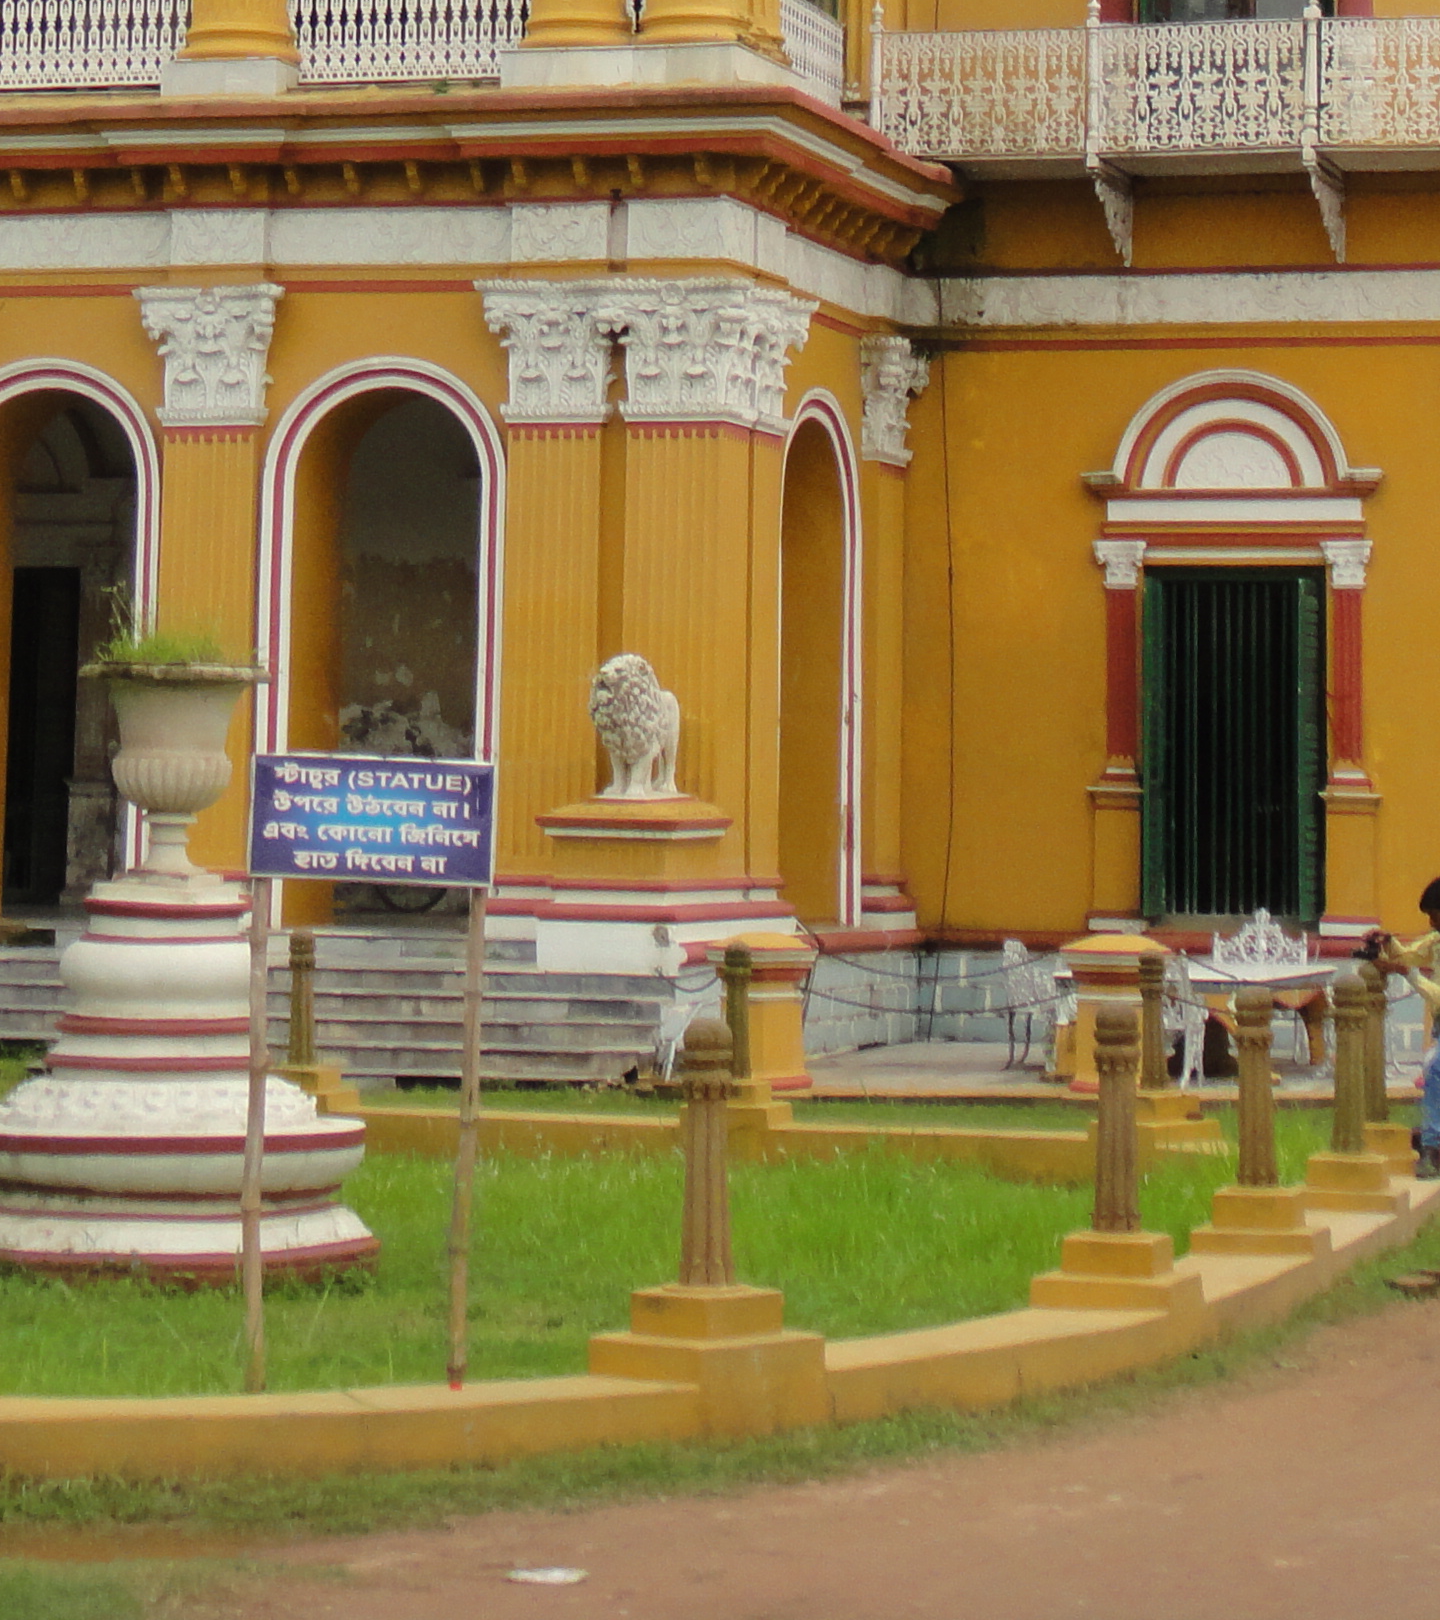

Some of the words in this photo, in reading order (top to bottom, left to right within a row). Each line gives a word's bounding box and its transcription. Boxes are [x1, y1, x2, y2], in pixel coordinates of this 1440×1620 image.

[348, 770, 472, 796] (STATUE)
[273, 789, 340, 814] উপরে
[346, 792, 427, 818] উঠবেন
[263, 821, 309, 840] এবং
[317, 824, 393, 843] কোনো
[399, 822, 481, 849] জিনিসে
[293, 850, 339, 869] হাত
[345, 847, 415, 873] দিবেন
[420, 855, 448, 874] না
